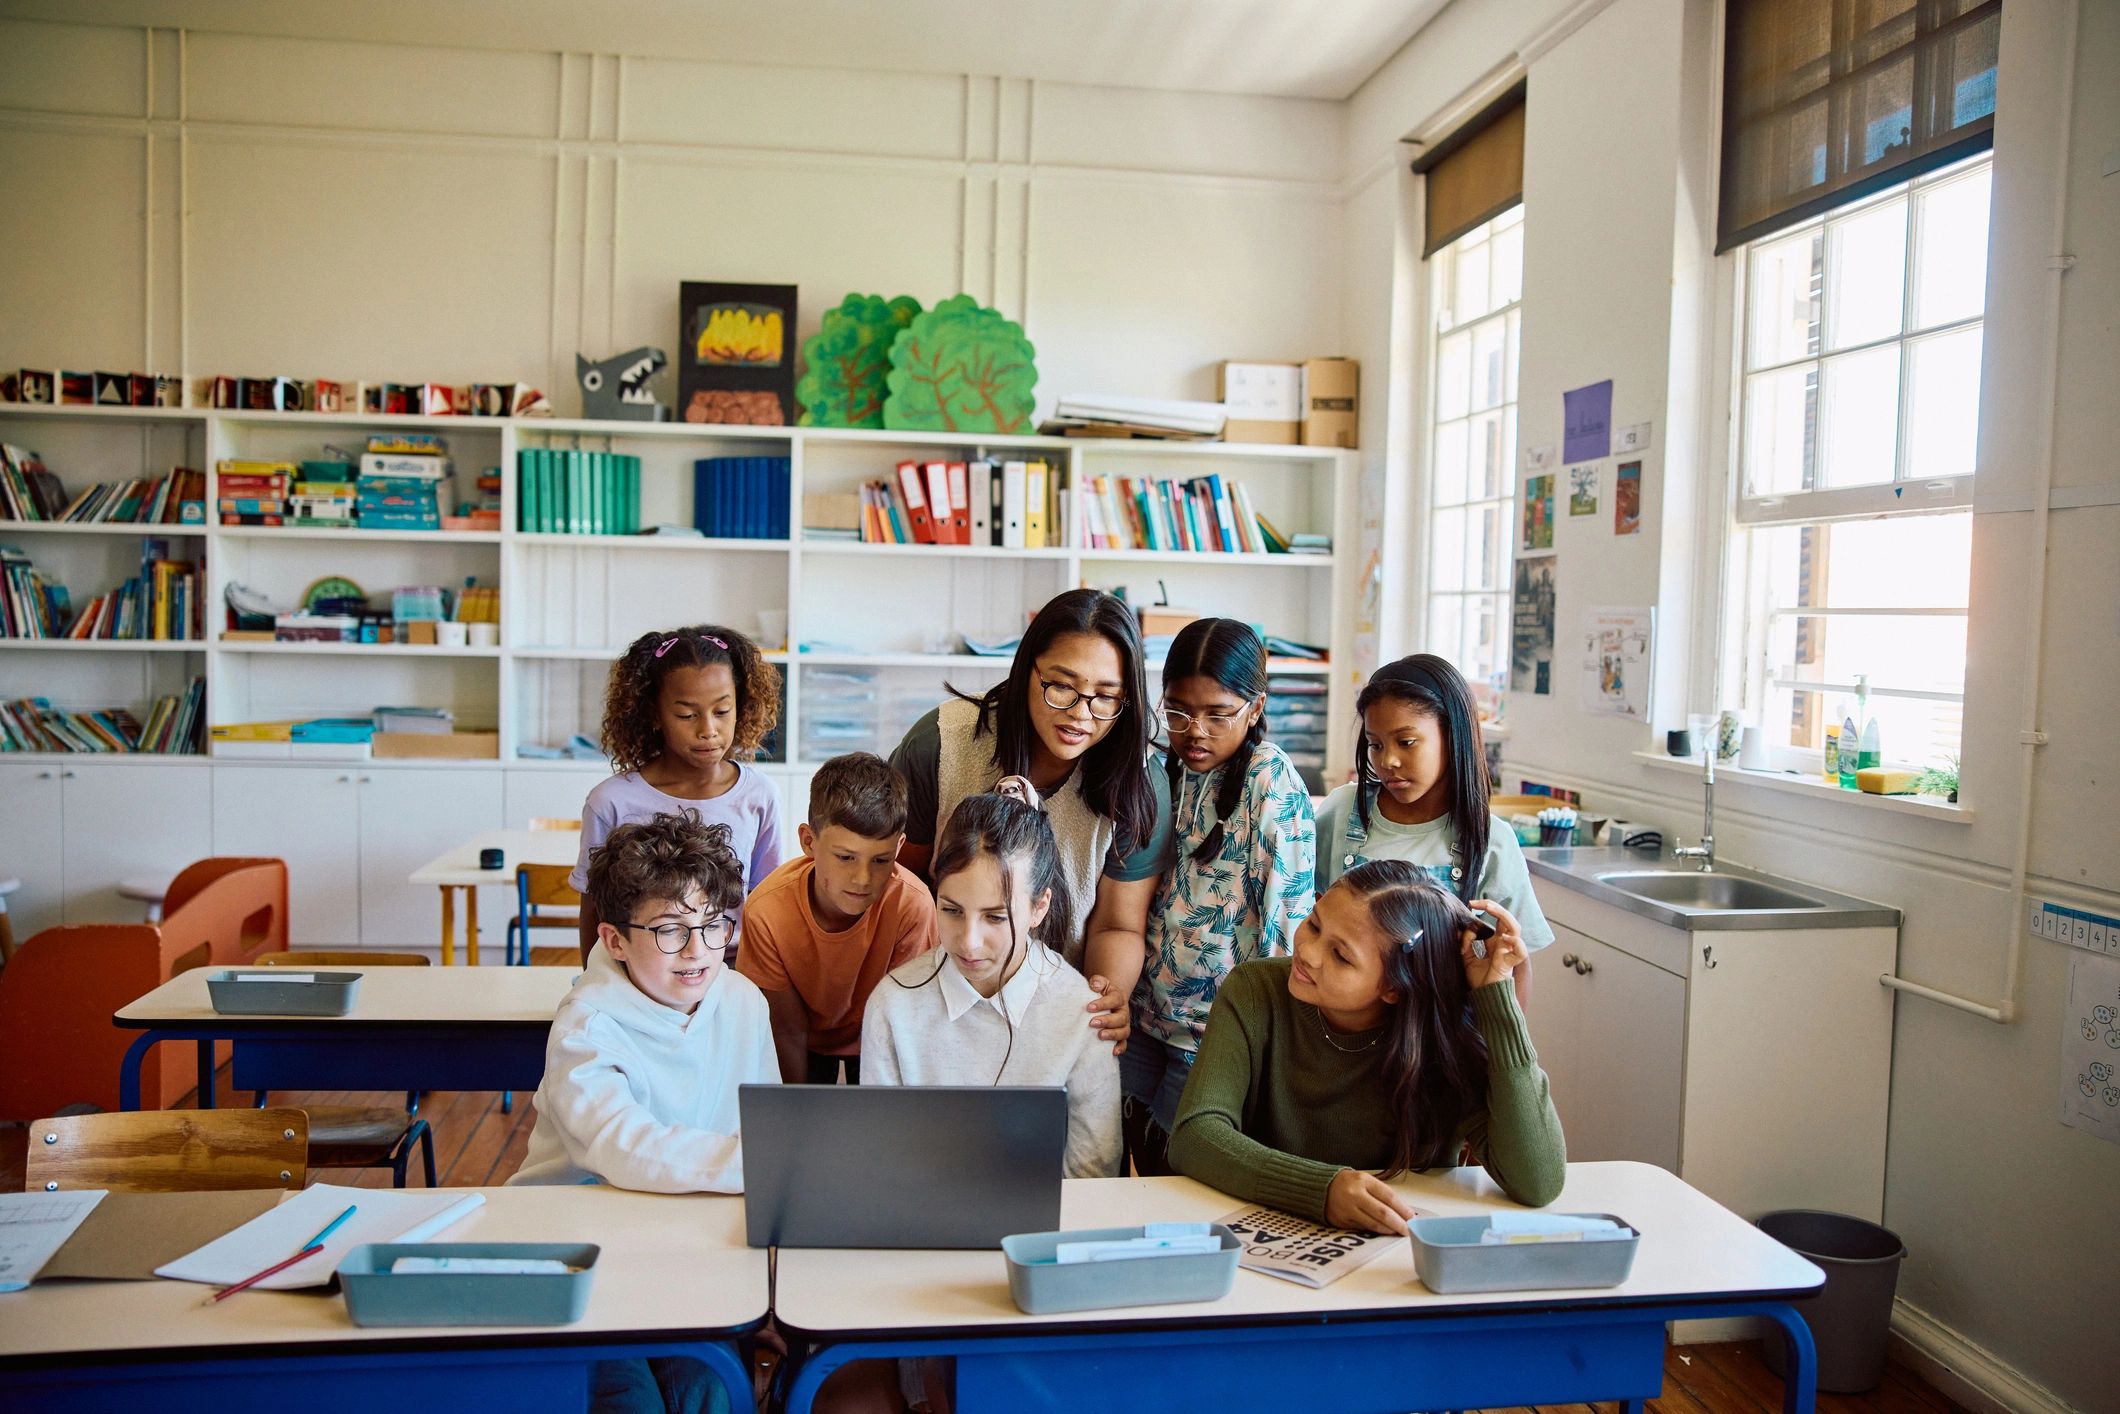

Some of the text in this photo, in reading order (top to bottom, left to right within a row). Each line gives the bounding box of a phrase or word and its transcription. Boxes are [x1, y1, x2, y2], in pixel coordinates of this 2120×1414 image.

[2033, 915, 2118, 948] 0 1 2 3 4 5
[1226, 1223, 1287, 1244] A4
[1296, 1228, 1380, 1266] RCISE
